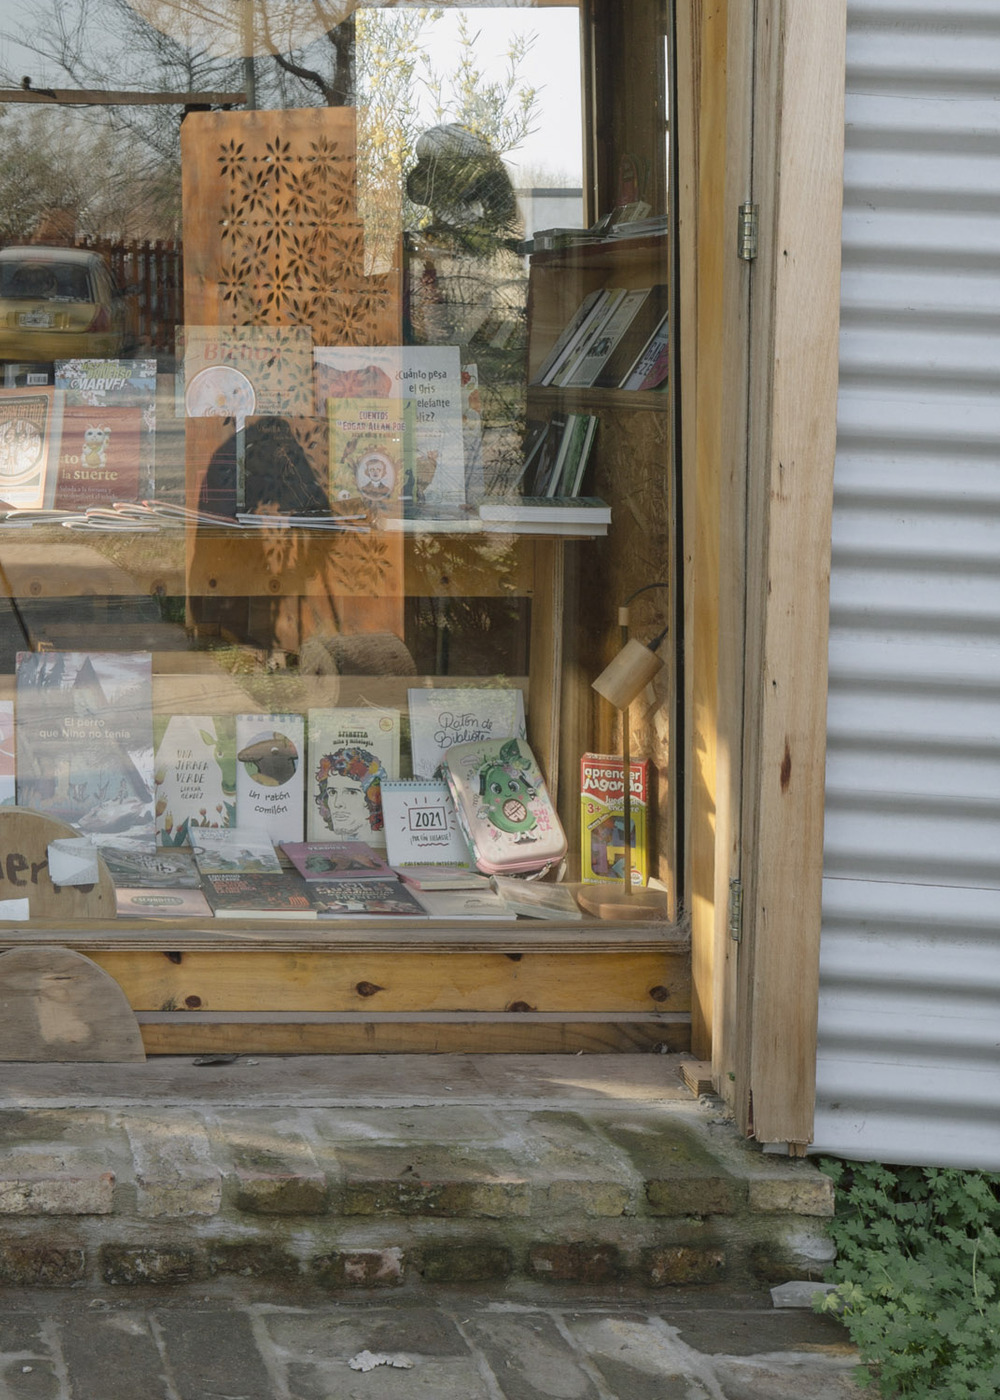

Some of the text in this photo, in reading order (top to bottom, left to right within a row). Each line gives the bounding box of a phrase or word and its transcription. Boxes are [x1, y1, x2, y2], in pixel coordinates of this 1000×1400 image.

[395, 368, 447, 381] ¿Cuánto pesa
[419, 383, 436, 394] gris
[417, 398, 450, 408] elefante
[359, 411, 389, 420] CUENTOS
[343, 421, 366, 431] EDGAR
[368, 420, 390, 431] ALLAN
[392, 421, 405, 431] POE
[62, 469, 118, 481] la suerte
[65, 717, 105, 730] El perro
[438, 711, 493, 732] Ratón de
[39, 729, 58, 739] que
[88, 730, 102, 738] no
[104, 727, 131, 739] tenía
[176, 772, 206, 783] VERDE
[265, 791, 290, 801] ratón
[254, 803, 288, 815] comilón
[587, 802, 602, 814] 3+
[415, 811, 442, 828] 2021
